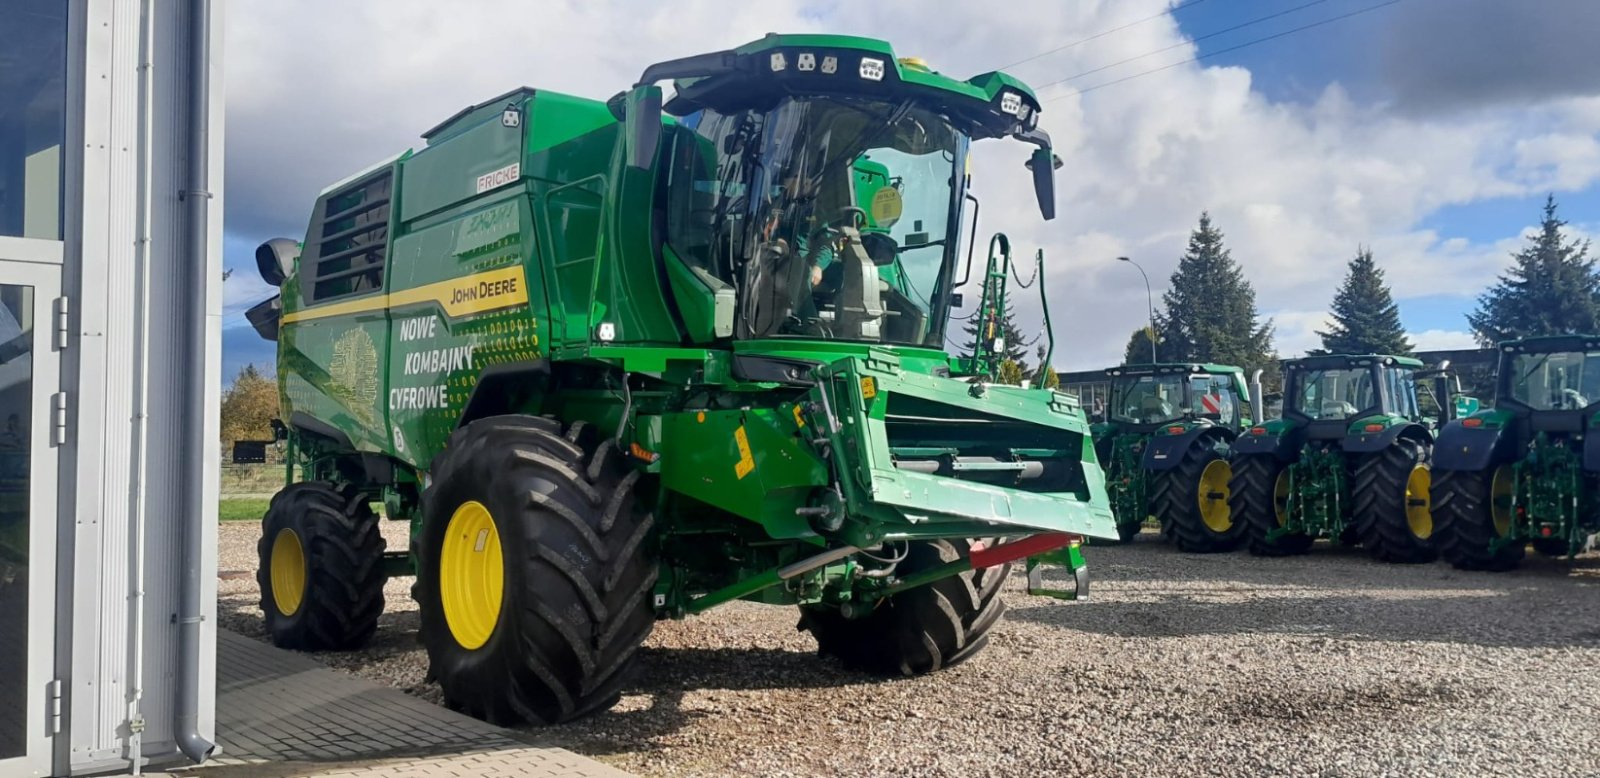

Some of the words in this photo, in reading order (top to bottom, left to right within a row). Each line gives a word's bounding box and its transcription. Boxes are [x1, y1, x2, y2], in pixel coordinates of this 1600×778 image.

[478, 165, 518, 192] FRICKE
[450, 286, 477, 304] JOHN
[479, 277, 517, 299] DEERE
[400, 315, 437, 342] NOWE
[404, 345, 474, 377] KOMBAJNY
[389, 384, 448, 410] CYFROWE
